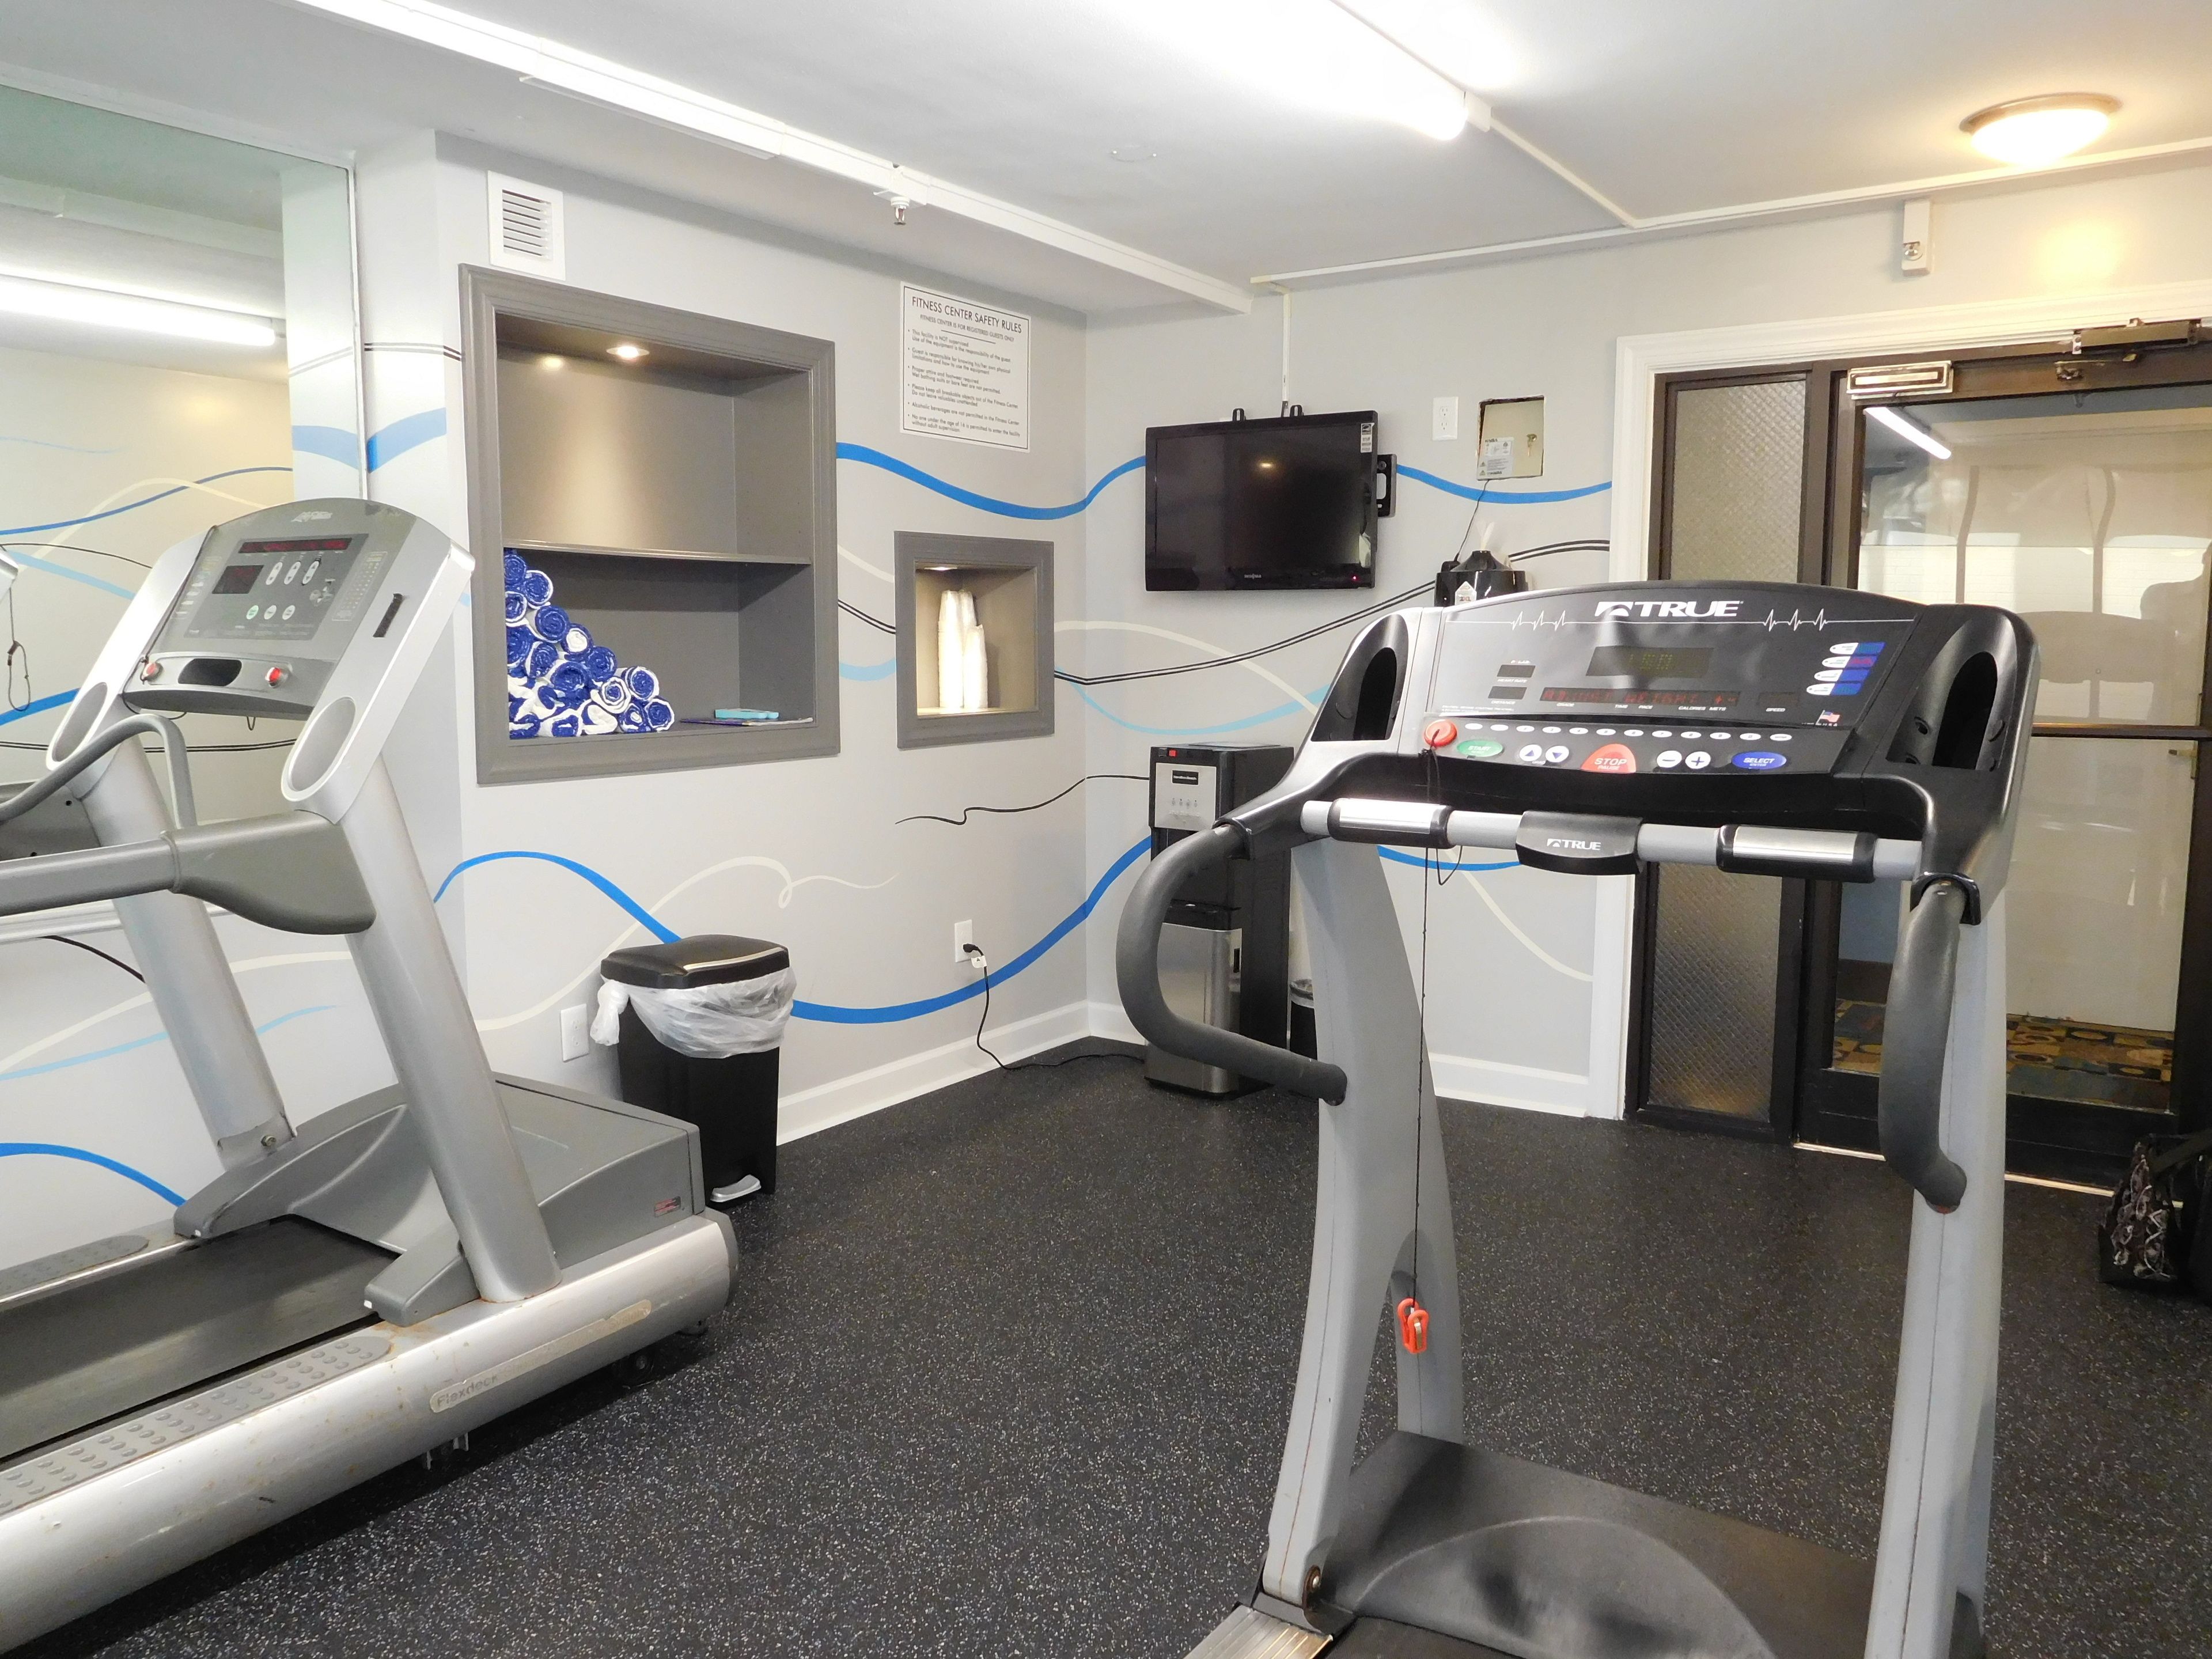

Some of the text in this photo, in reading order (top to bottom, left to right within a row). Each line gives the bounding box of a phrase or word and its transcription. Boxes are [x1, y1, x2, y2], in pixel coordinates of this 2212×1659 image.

[912, 296, 1021, 332] FITNESS CENTER SAFETY RULES
[920, 314, 935, 323] FITNESS
[937, 318, 952, 326] CENTER
[958, 358, 973, 366] knowing
[930, 405, 950, 413] beverages
[1634, 600, 1740, 617] TRUE
[1594, 757, 1627, 766] STOP
[1562, 839, 1601, 850] TRUE
